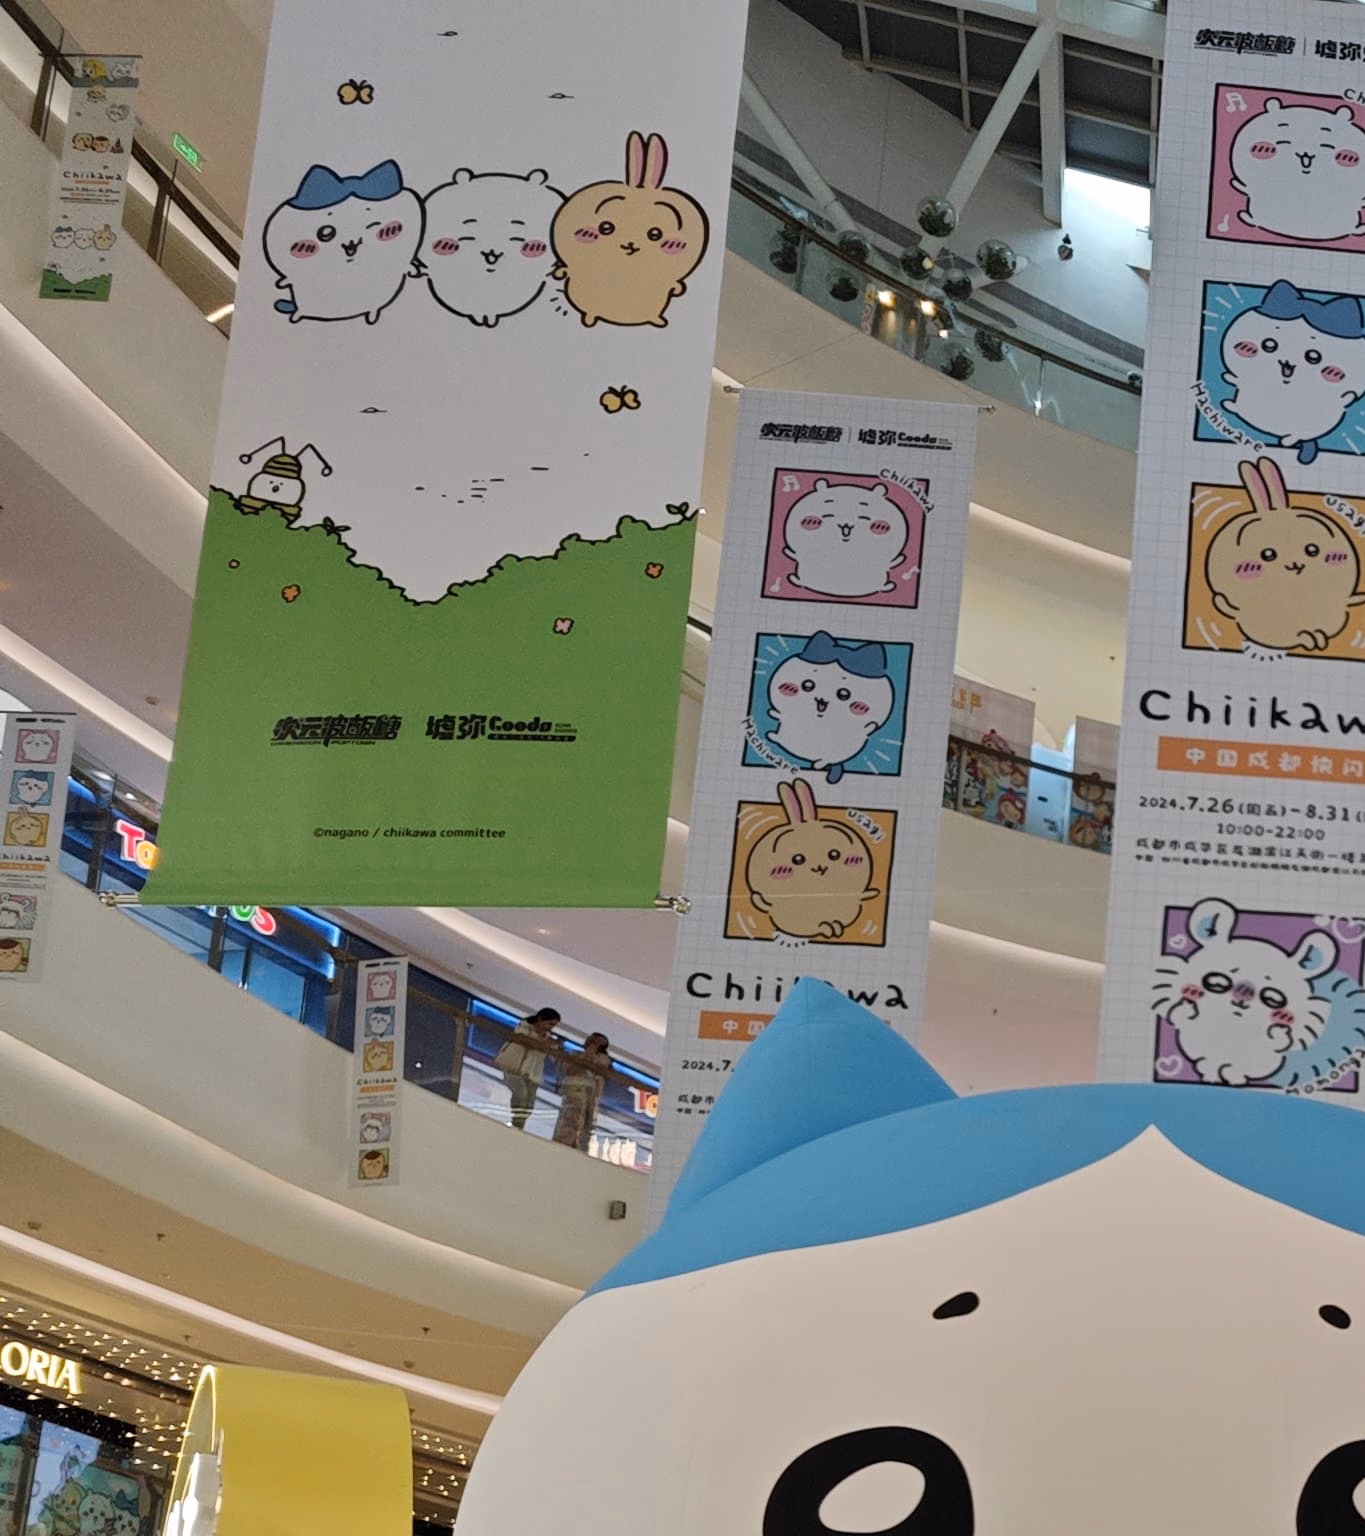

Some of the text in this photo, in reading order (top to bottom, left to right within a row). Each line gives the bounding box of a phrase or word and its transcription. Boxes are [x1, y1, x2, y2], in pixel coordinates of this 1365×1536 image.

[1190, 382, 1264, 452] Hachiware
[880, 468, 935, 514] Chiikawa
[741, 718, 799, 774] Hachiware
[383, 827, 437, 838] chiikawa
[440, 827, 506, 838] committee
[1217, 823, 1326, 841] 10:00-22:00
[686, 972, 909, 1010] Chiiwa
[0, 1341, 83, 1395] ORIA
